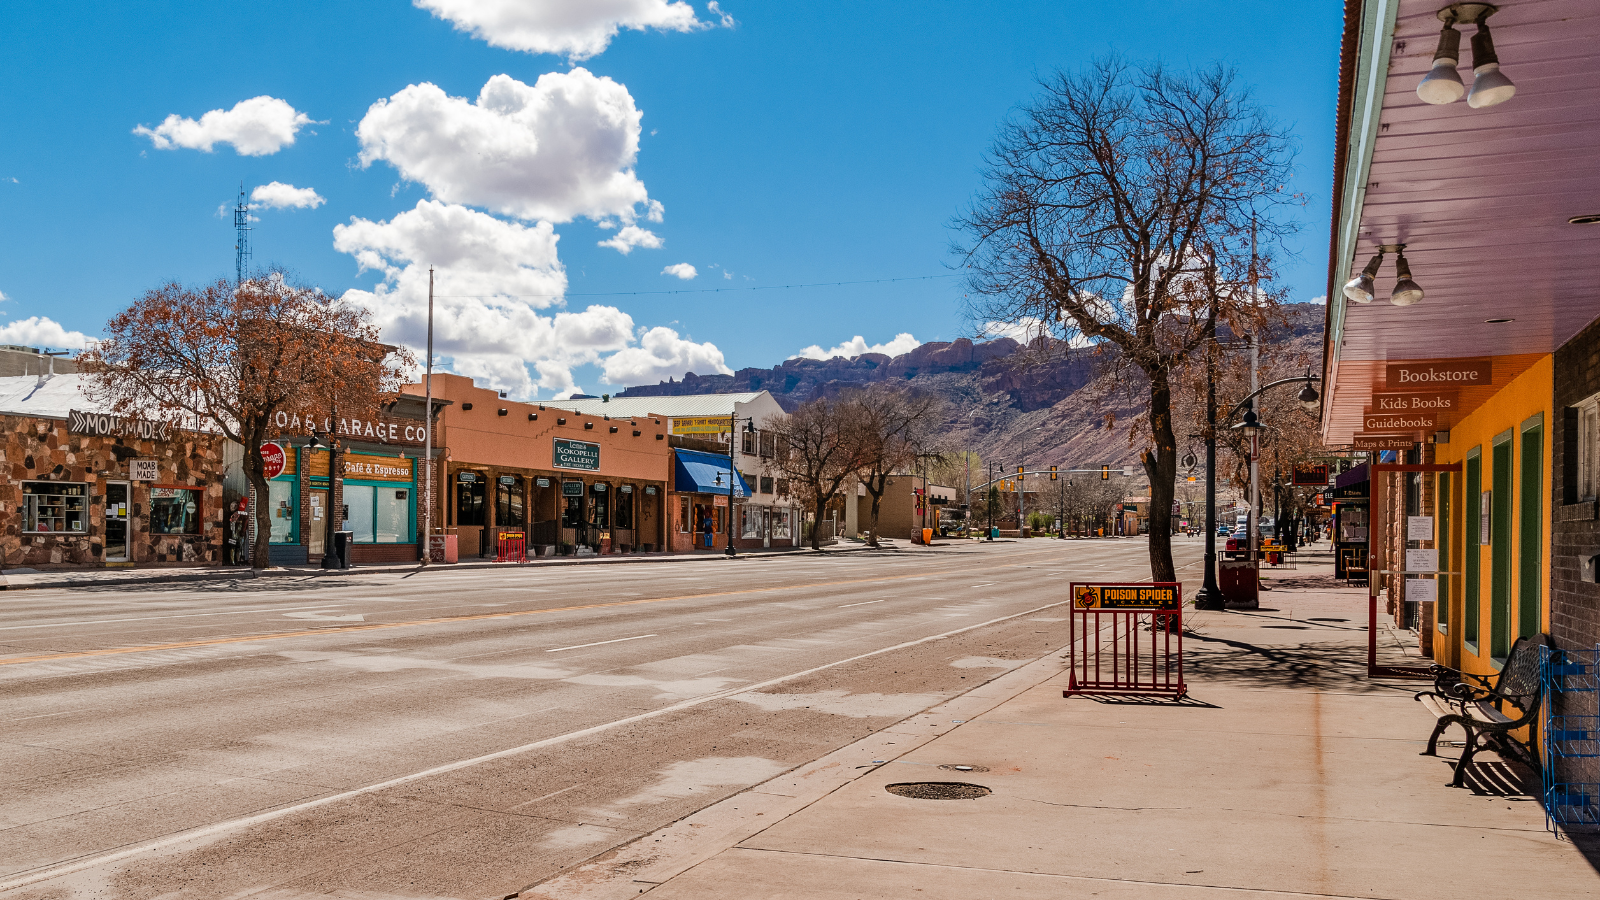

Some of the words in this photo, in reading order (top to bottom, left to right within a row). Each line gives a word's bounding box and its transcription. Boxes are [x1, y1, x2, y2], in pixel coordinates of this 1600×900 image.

[1399, 368, 1478, 382] Bookstore
[1380, 398, 1408, 410] Kids
[1412, 397, 1450, 409] Books
[86, 414, 124, 436] MOAB
[126, 420, 158, 440] MADE
[1366, 417, 1432, 428] Guidebooks
[1355, 440, 1376, 449] Maps
[557, 447, 597, 457] KOKOPELLI
[560, 455, 594, 464] GALLERY
[137, 462, 155, 470] MOAB
[345, 462, 363, 473] Café
[366, 464, 372, 474] &
[374, 464, 409, 477] Espresso
[1104, 589, 1137, 600] POISON
[1140, 589, 1172, 600] SPIDER
